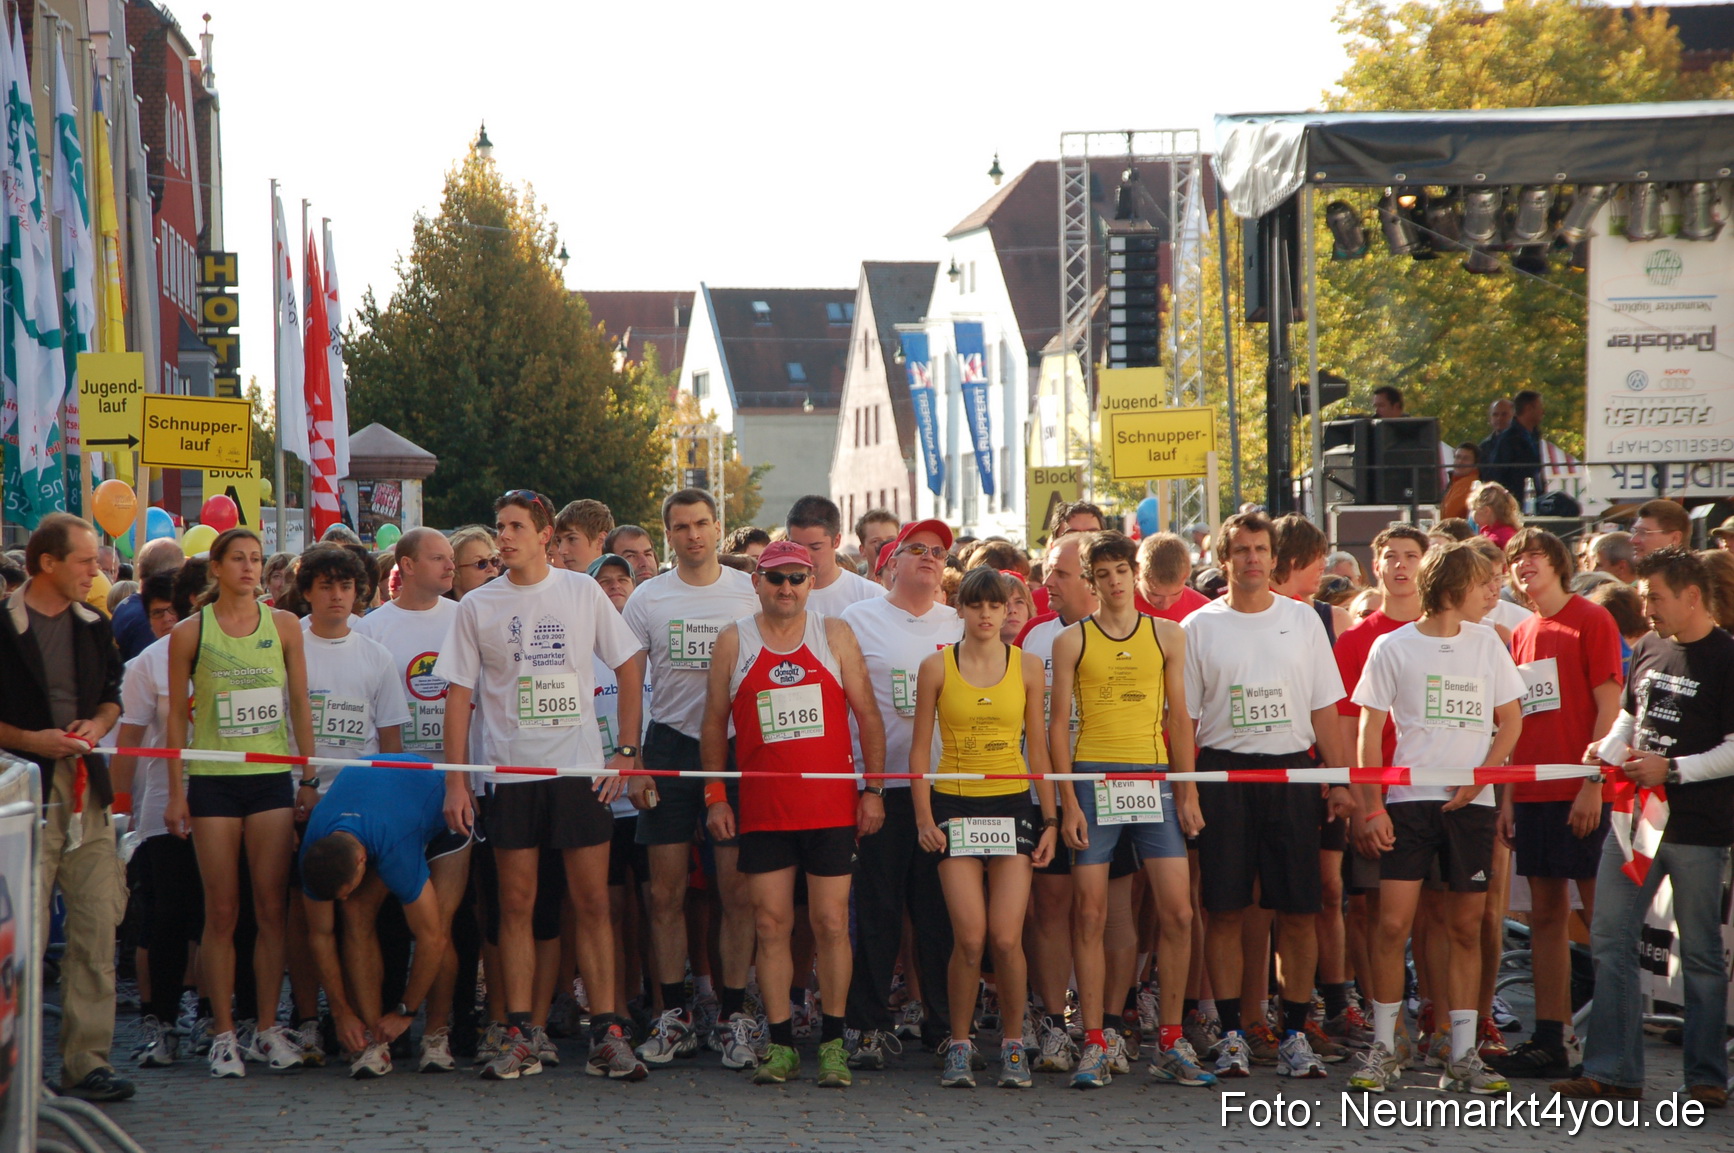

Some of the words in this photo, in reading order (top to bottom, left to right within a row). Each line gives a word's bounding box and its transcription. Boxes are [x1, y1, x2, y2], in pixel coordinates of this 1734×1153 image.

[204, 255, 237, 397] HOTE
[81, 379, 143, 398] Jugend-
[98, 398, 127, 413] lauf
[1103, 394, 1164, 410] Jugend-
[973, 386, 989, 452] RUPPERT
[1604, 406, 1714, 427] FISCHER
[148, 414, 243, 435] Schnupper-
[180, 436, 211, 452] lauf
[1117, 429, 1207, 444] Schnupper-
[1148, 447, 1177, 462] lauf
[1034, 469, 1077, 484] Block
[224, 485, 248, 525] A
[686, 623, 719, 634] Matthes
[533, 633, 565, 641] 16.09.2007
[687, 641, 715, 656] 515
[532, 659, 565, 667] Stadtlauf
[212, 669, 231, 677] new
[234, 666, 273, 676] balance
[535, 680, 565, 690] Markus
[1444, 679, 1478, 693] Benedikt
[1246, 687, 1283, 699] Wolfgang
[327, 699, 364, 712] Ferdinand
[419, 705, 445, 715] Marku
[538, 696, 577, 713] 5085
[1250, 703, 1287, 720] 5131
[1446, 699, 1482, 716] 5128
[237, 704, 277, 722] 5166
[778, 708, 818, 726] 5186
[327, 718, 364, 735] 5122
[421, 722, 441, 737] 50
[1112, 779, 1135, 788] Kevin
[1116, 795, 1156, 809] 5080
[967, 818, 1001, 826] Vanessa
[970, 832, 1010, 843] 5000
